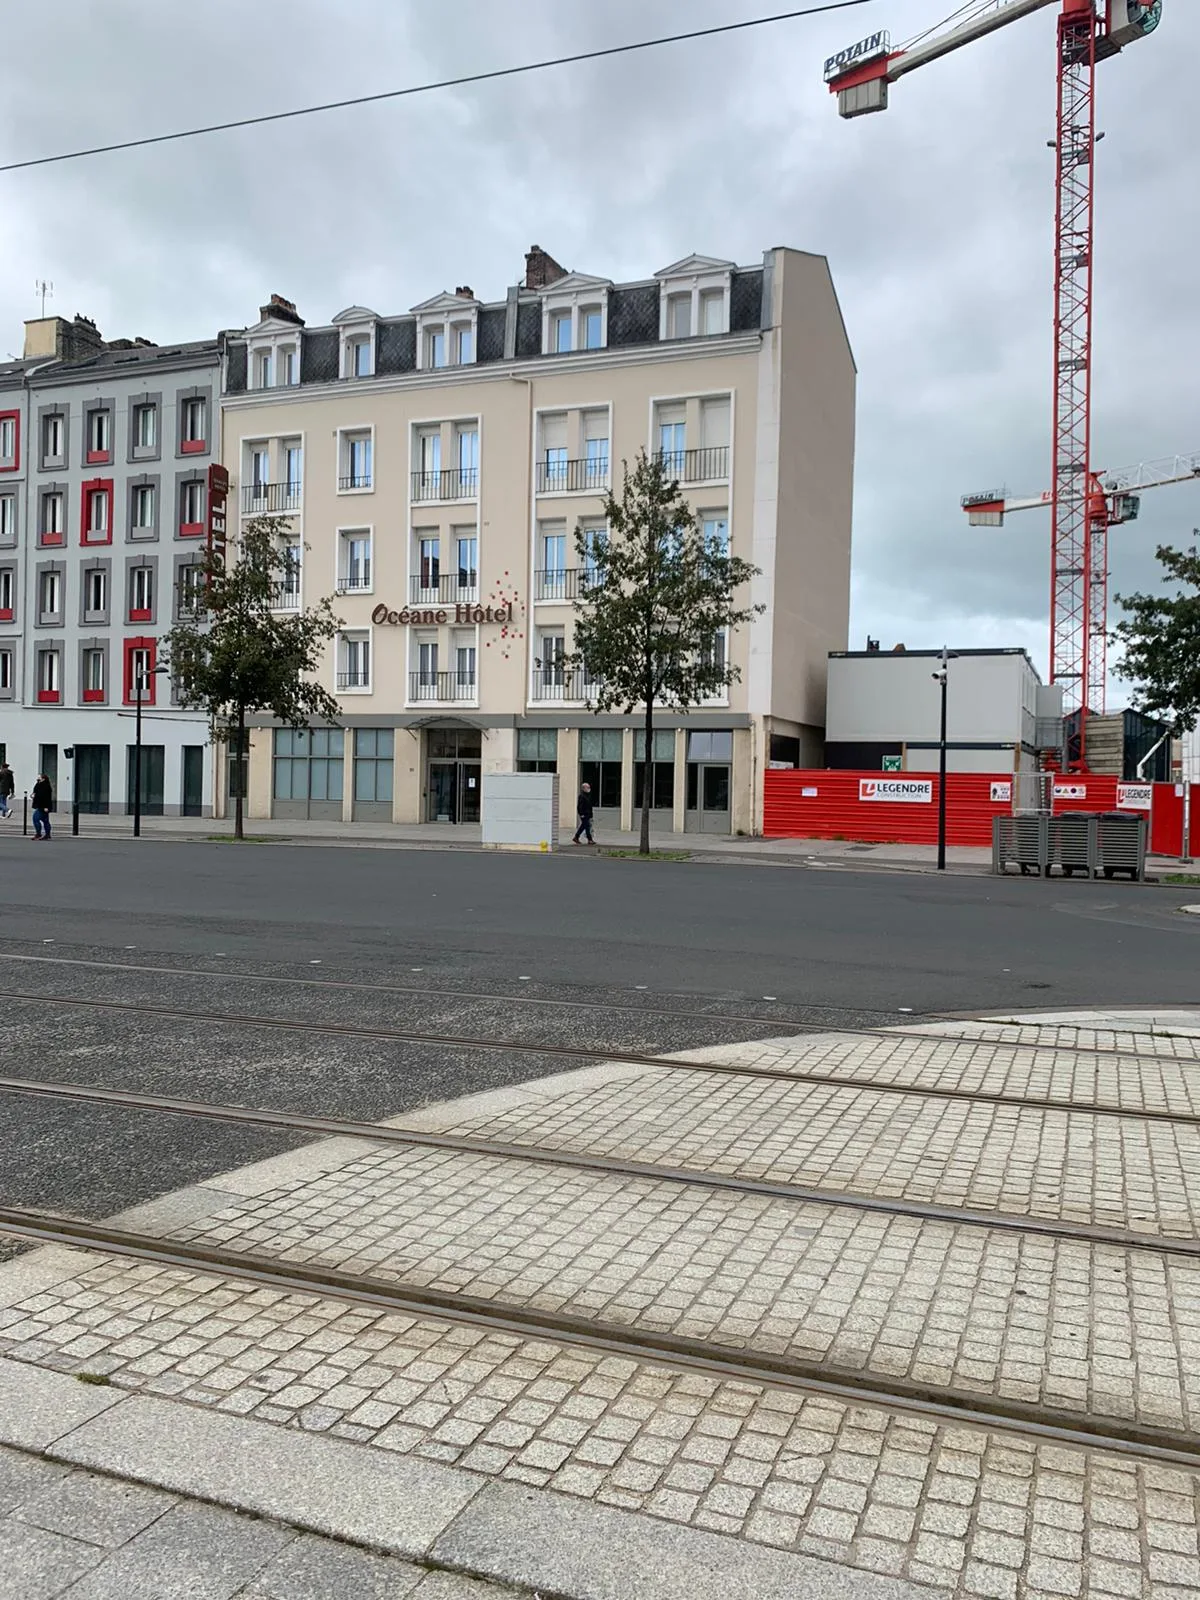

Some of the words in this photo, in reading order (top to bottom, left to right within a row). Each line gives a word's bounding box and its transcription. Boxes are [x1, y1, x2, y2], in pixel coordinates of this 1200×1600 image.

[825, 32, 881, 72] POTAIN
[372, 603, 447, 625] Océane
[455, 602, 513, 624] Hôtel
[877, 783, 930, 793] LEGENDRE
[1126, 788, 1151, 799] LEGENDRE
